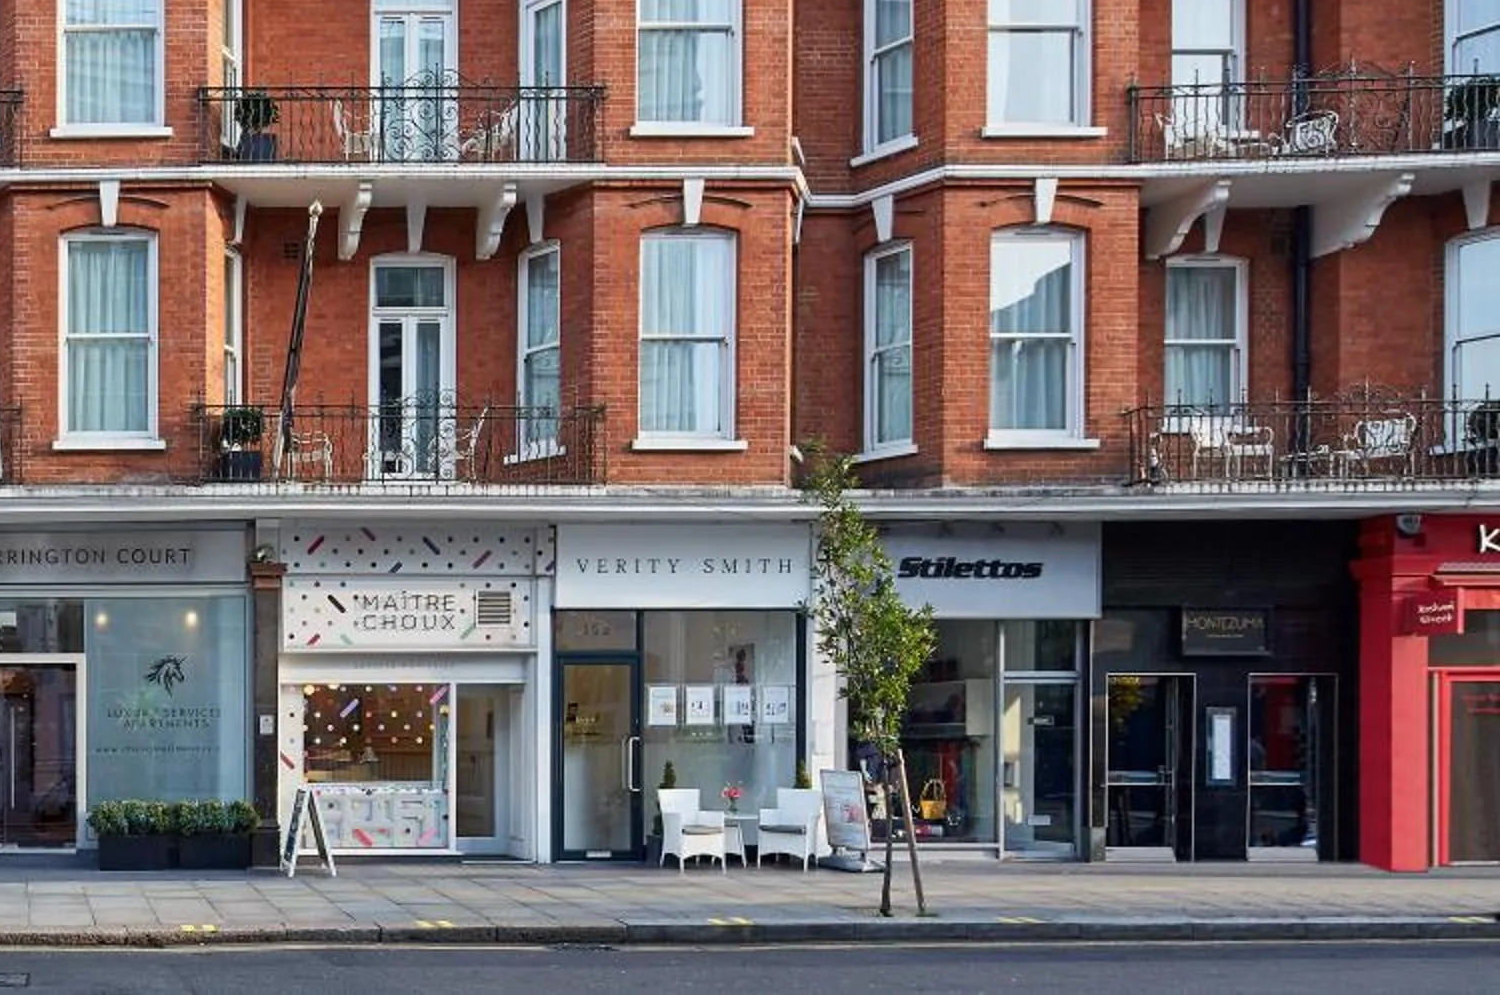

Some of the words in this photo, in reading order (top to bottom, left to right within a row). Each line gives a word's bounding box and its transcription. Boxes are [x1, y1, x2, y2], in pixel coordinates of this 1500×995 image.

[117, 548, 191, 565] COURT
[577, 558, 681, 574] VERITY
[702, 558, 792, 574] SMITH
[898, 556, 1043, 578] Stilettos
[363, 614, 455, 630] CHOUX
